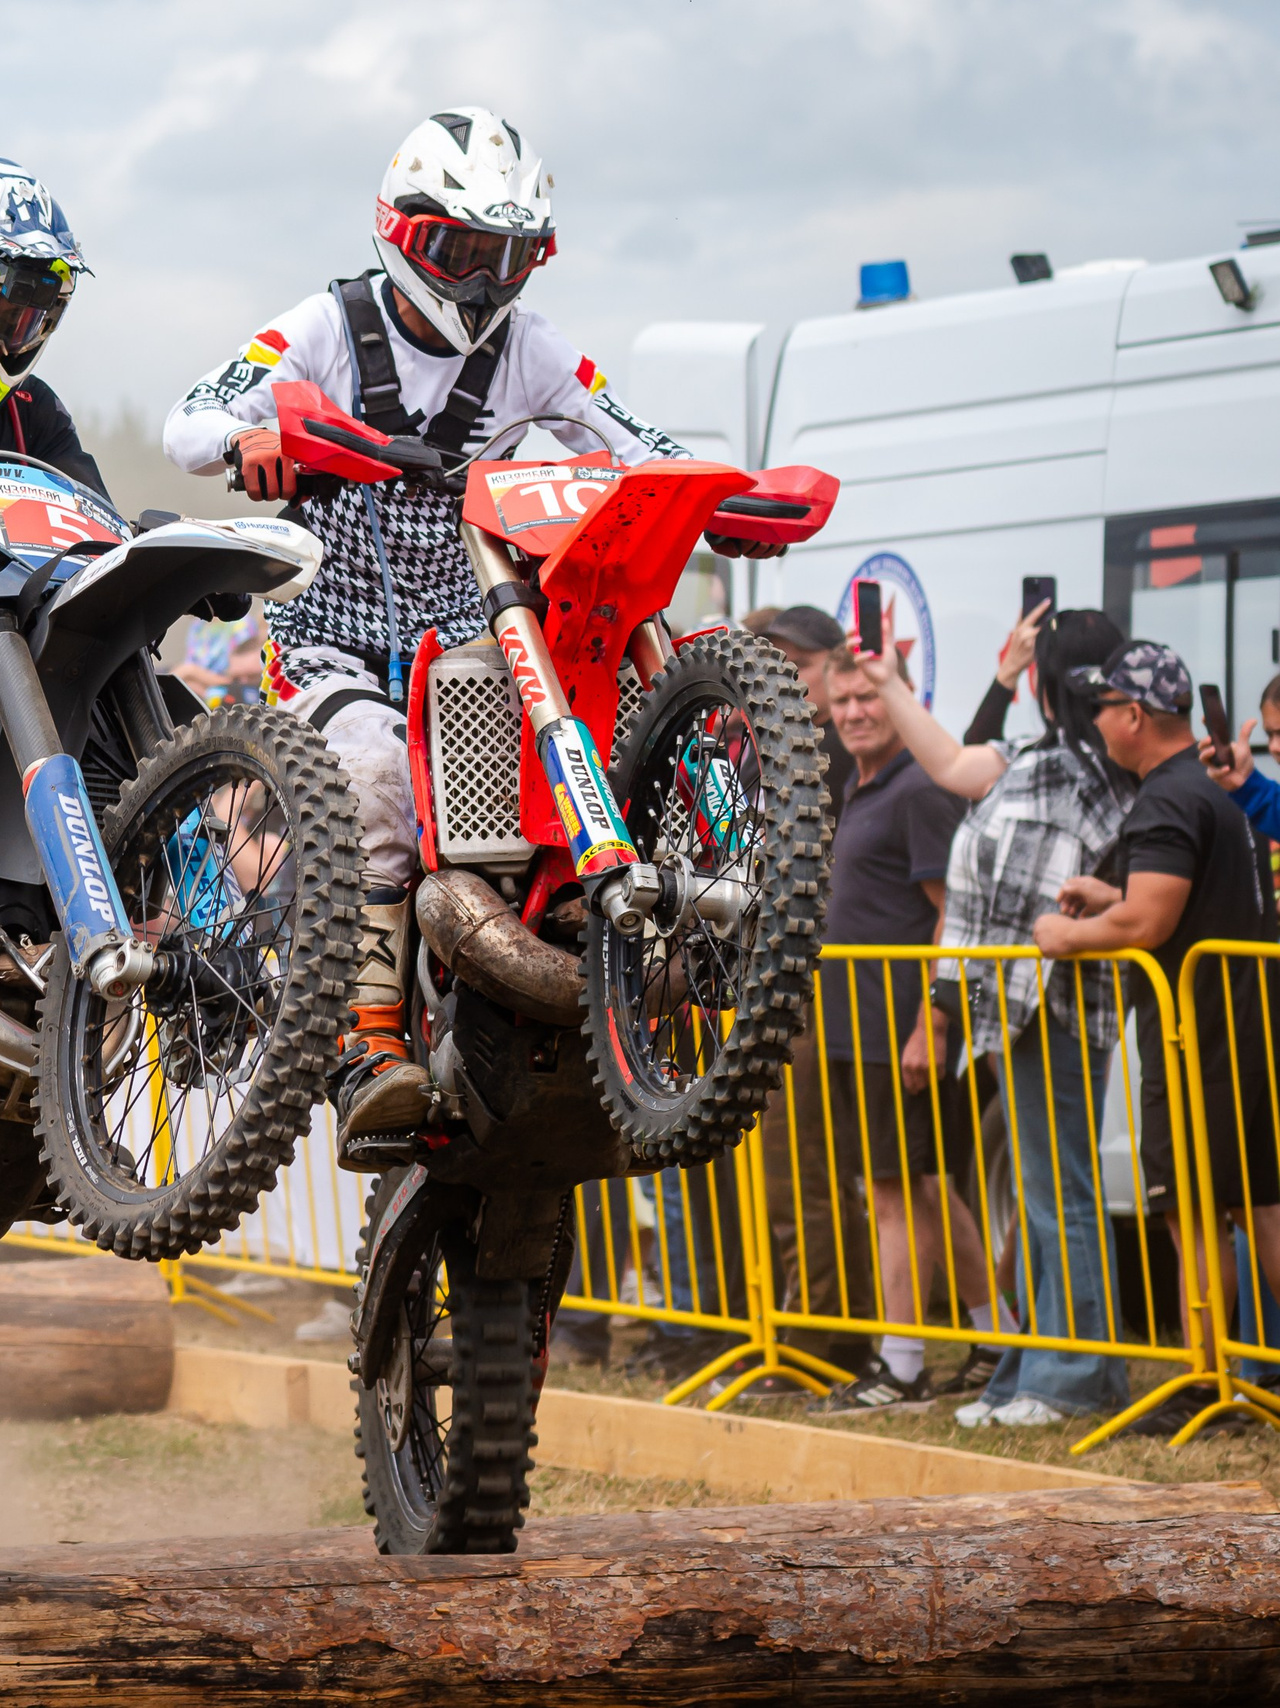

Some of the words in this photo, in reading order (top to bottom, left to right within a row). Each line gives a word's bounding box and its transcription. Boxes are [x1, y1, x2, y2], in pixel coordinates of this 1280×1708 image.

[13, 469, 25, 479] V.
[491, 469, 556, 485] КУЗЯМБАЙ
[519, 481, 608, 517] 10
[45, 504, 95, 550] 5
[565, 747, 611, 830] DUNLOP
[58, 793, 115, 922] DUNLOP
[582, 841, 636, 865] ACERBIS
[72, 1134, 88, 1167] EXCEL
